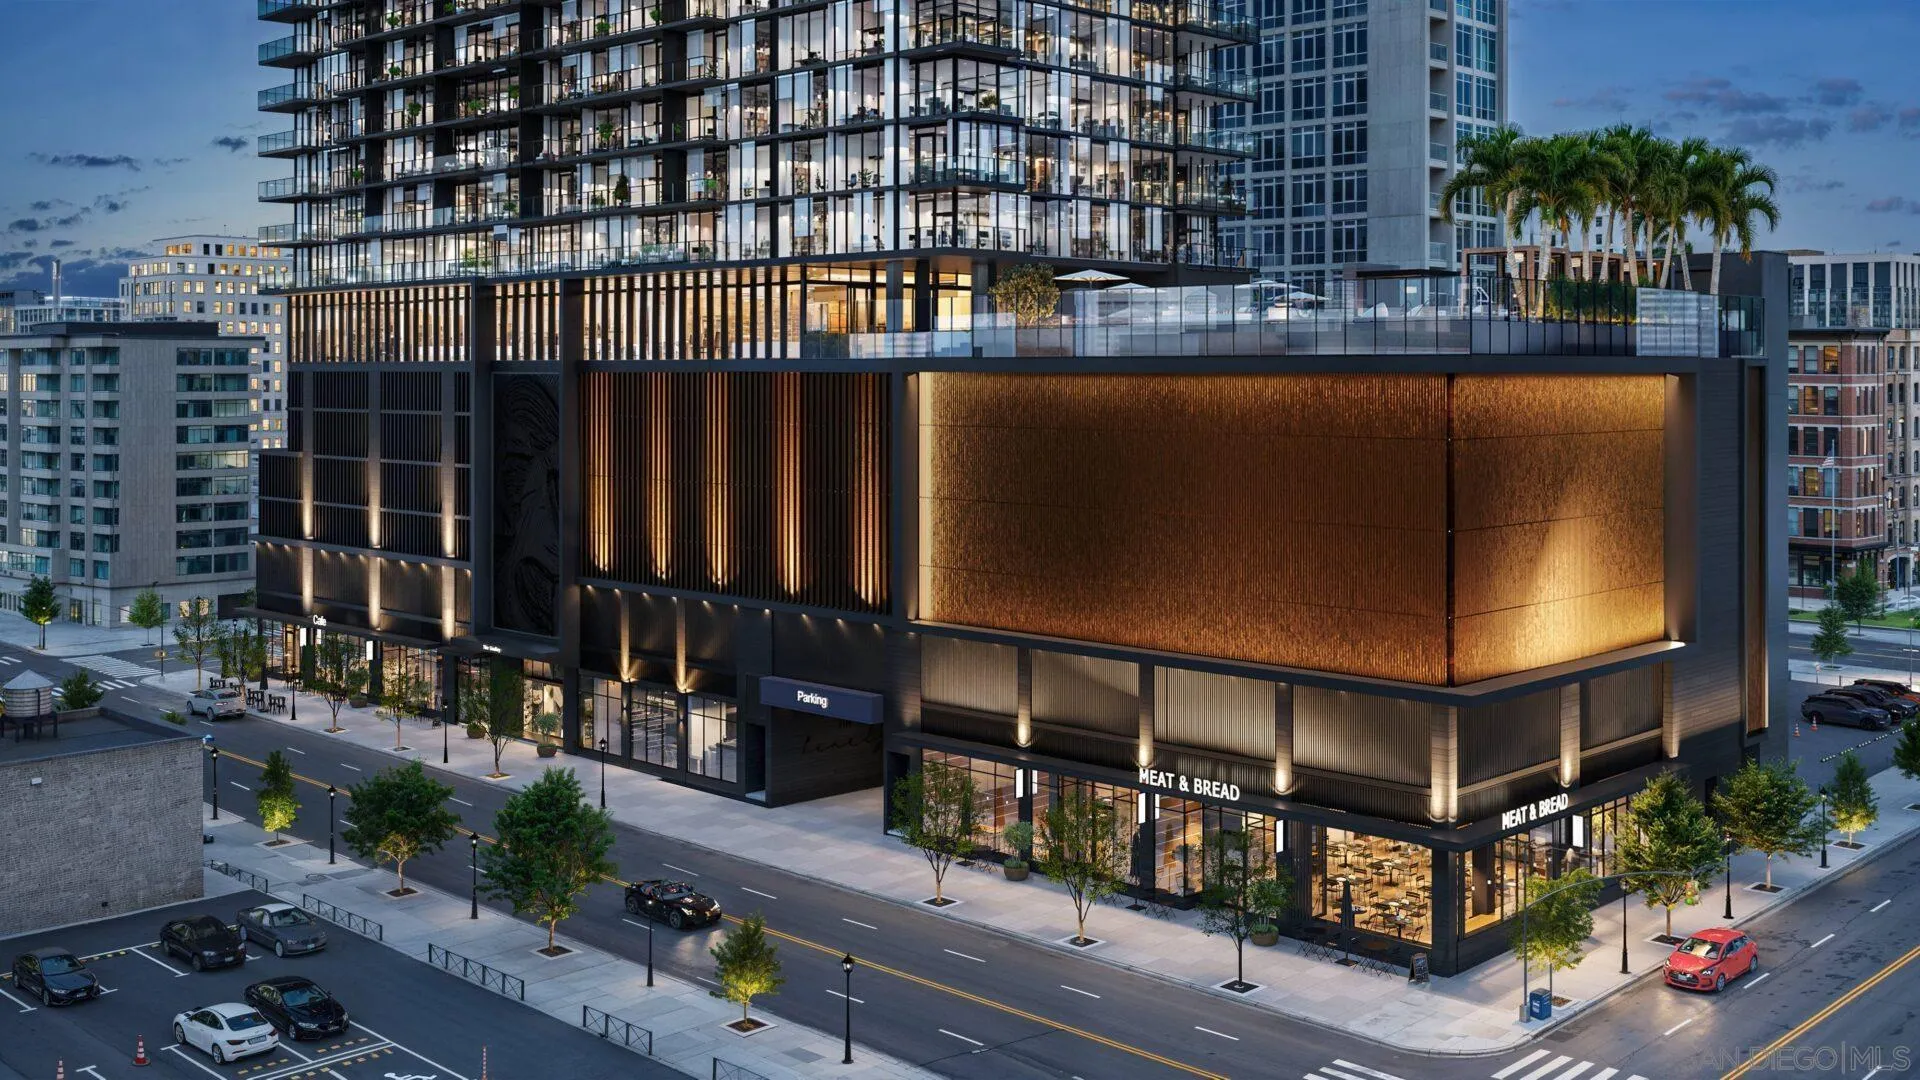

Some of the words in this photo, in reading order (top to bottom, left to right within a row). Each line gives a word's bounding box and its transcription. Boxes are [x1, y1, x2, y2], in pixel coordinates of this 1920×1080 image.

[313, 614, 327, 627] Cafe
[797, 690, 828, 709] Parking
[1139, 768, 1175, 788] MEAT
[1179, 775, 1189, 792] &
[1193, 777, 1240, 800] BREAD
[1502, 806, 1528, 830] MEAT
[1529, 803, 1537, 820] &
[1538, 793, 1569, 818] BREAD
